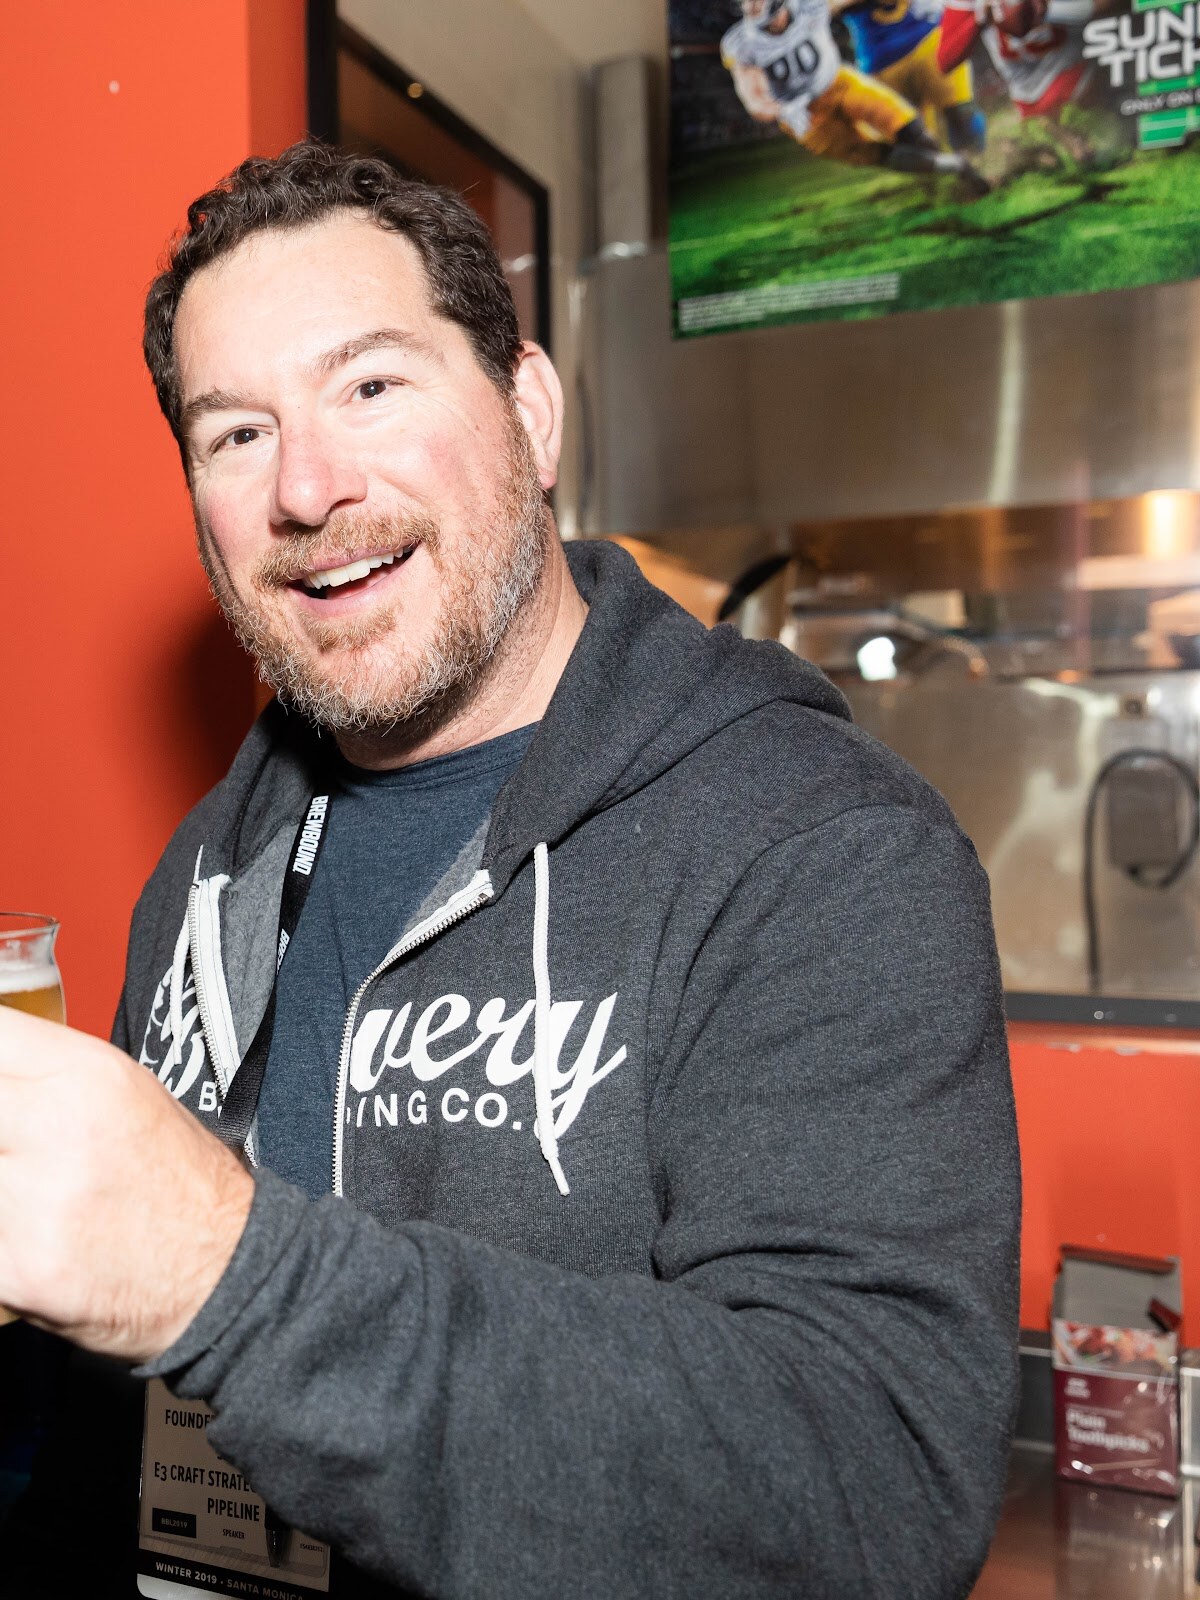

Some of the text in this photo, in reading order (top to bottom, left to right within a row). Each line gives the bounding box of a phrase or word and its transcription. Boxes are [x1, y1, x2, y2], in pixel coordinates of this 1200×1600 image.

[1082, 4, 1200, 59] SUN
[292, 795, 329, 876] BREWBOUND
[441, 1088, 522, 1131] CO.
[165, 1409, 217, 1430] FOUNDE
[154, 1461, 167, 1482] E3
[170, 1464, 206, 1485] CRAFT
[207, 1497, 261, 1522] PIPELINE
[160, 1517, 188, 1529] BBL2019
[222, 1528, 246, 1540] SPEAKER
[155, 1561, 192, 1579] WINTER
[194, 1570, 218, 1586] 2019
[226, 1578, 260, 1595] SANTA
